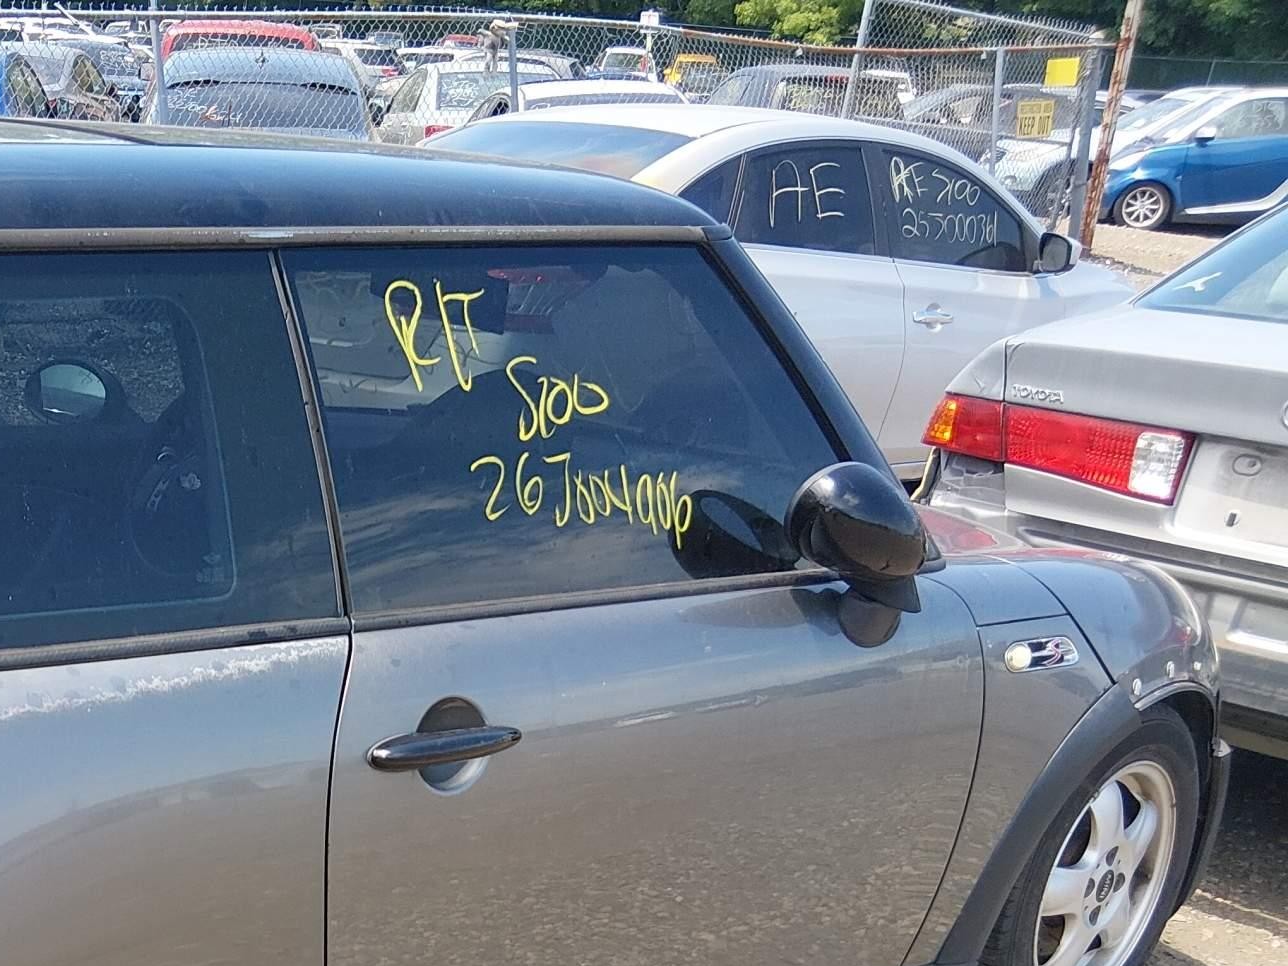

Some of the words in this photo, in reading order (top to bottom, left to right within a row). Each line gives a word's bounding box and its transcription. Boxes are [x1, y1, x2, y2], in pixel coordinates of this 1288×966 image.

[1018, 115, 1036, 136] KEEP
[1036, 115, 1051, 135] OUT
[768, 159, 846, 229] AE
[1012, 383, 1064, 404] TOYOTA
